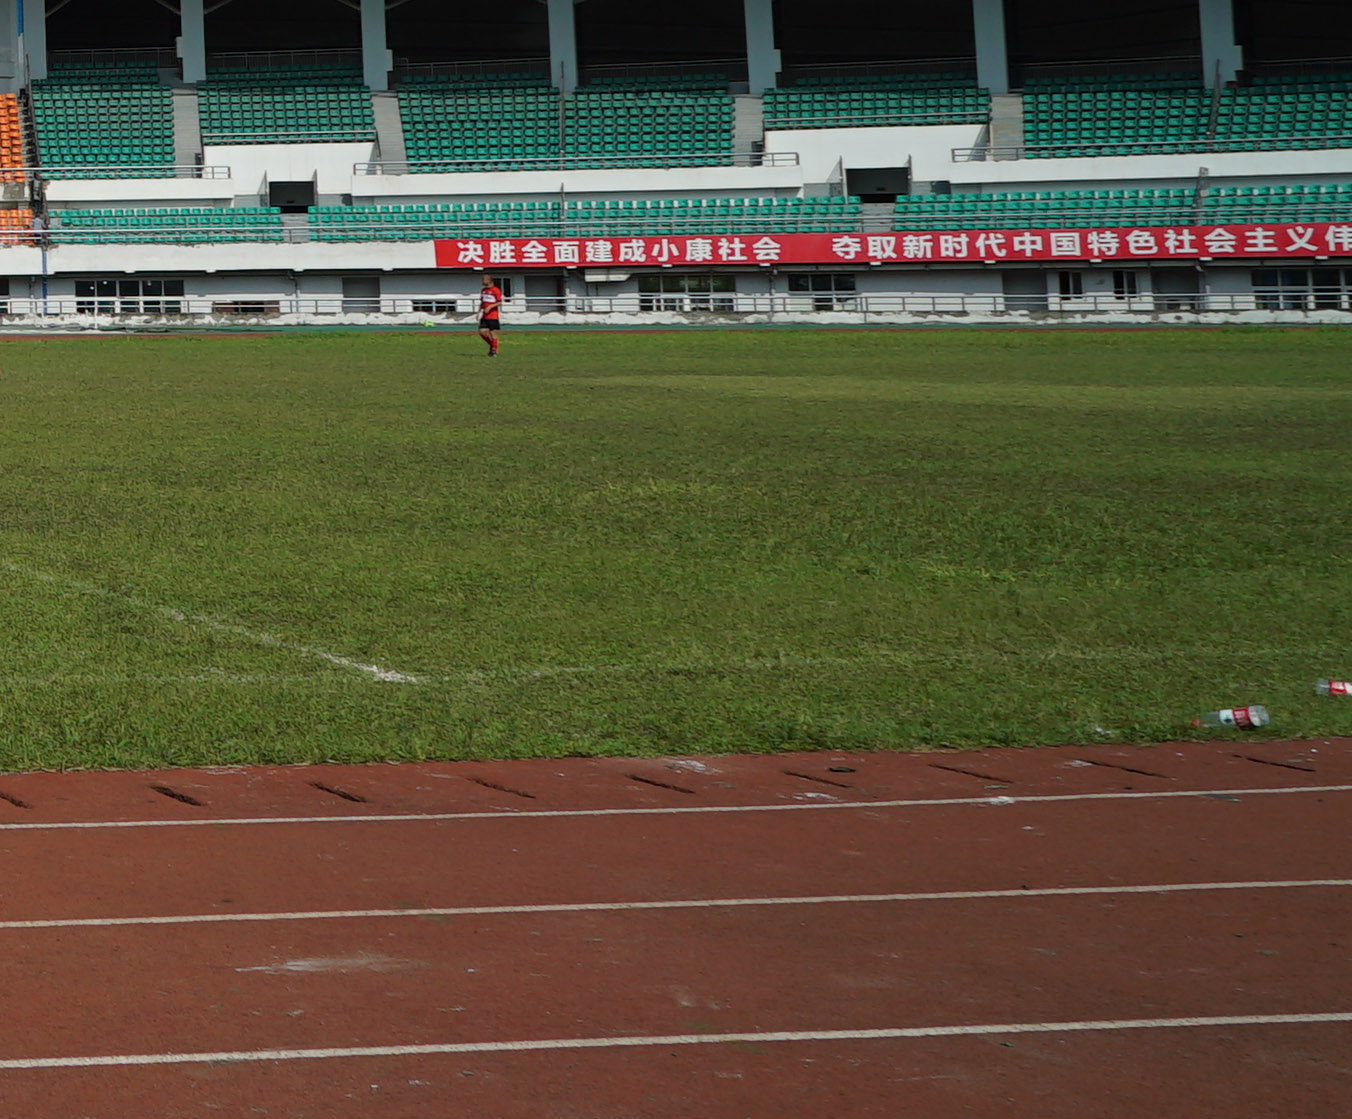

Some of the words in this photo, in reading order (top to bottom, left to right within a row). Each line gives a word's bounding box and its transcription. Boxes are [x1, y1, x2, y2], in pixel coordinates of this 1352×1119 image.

[456, 236, 782, 264] 决胜全面建成小康社会
